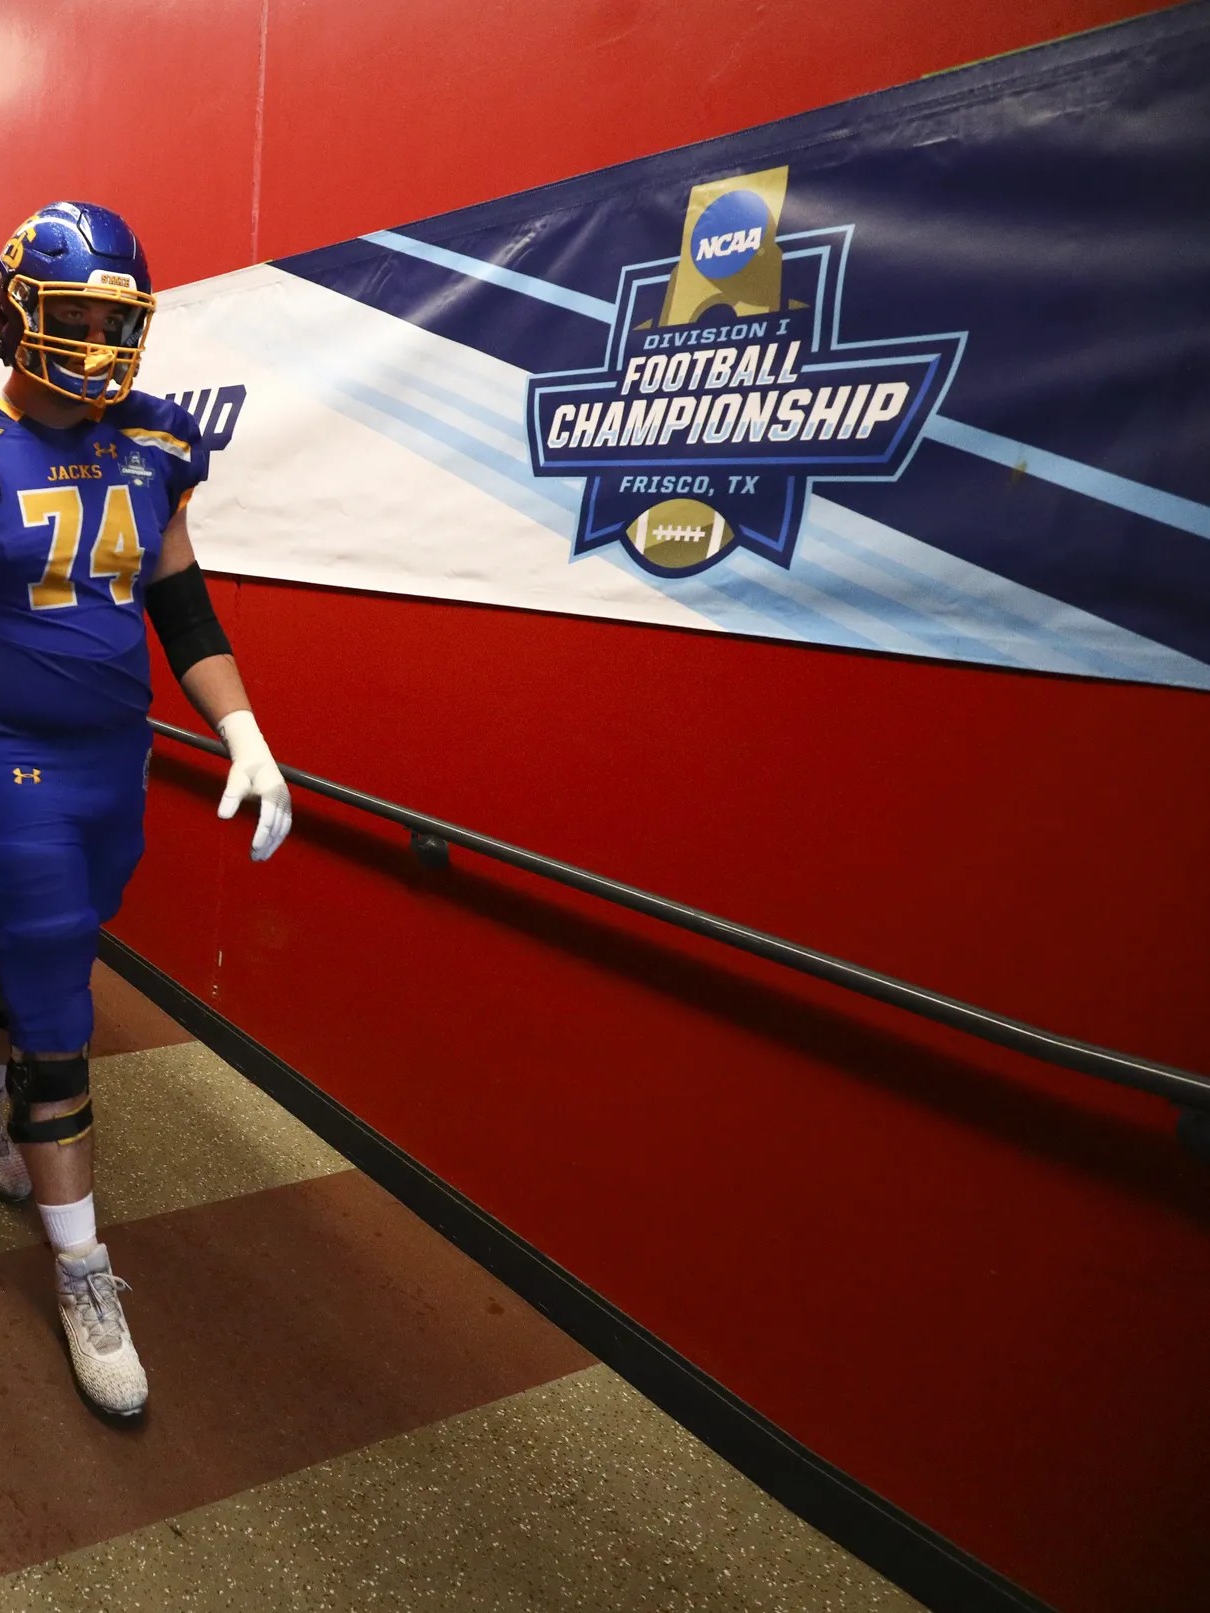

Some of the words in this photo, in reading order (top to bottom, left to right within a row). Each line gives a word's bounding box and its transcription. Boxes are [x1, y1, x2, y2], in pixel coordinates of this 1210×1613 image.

[696, 227, 762, 261] NCAA
[643, 321, 768, 349] DIVISION
[776, 319, 791, 335] I
[621, 341, 802, 395] FOOTBALL
[547, 381, 910, 449] CHAMPIONSHIP
[47, 464, 103, 481] JACKS
[619, 475, 715, 496] FRISCO,
[728, 475, 760, 495] TX
[17, 484, 145, 611] 74
